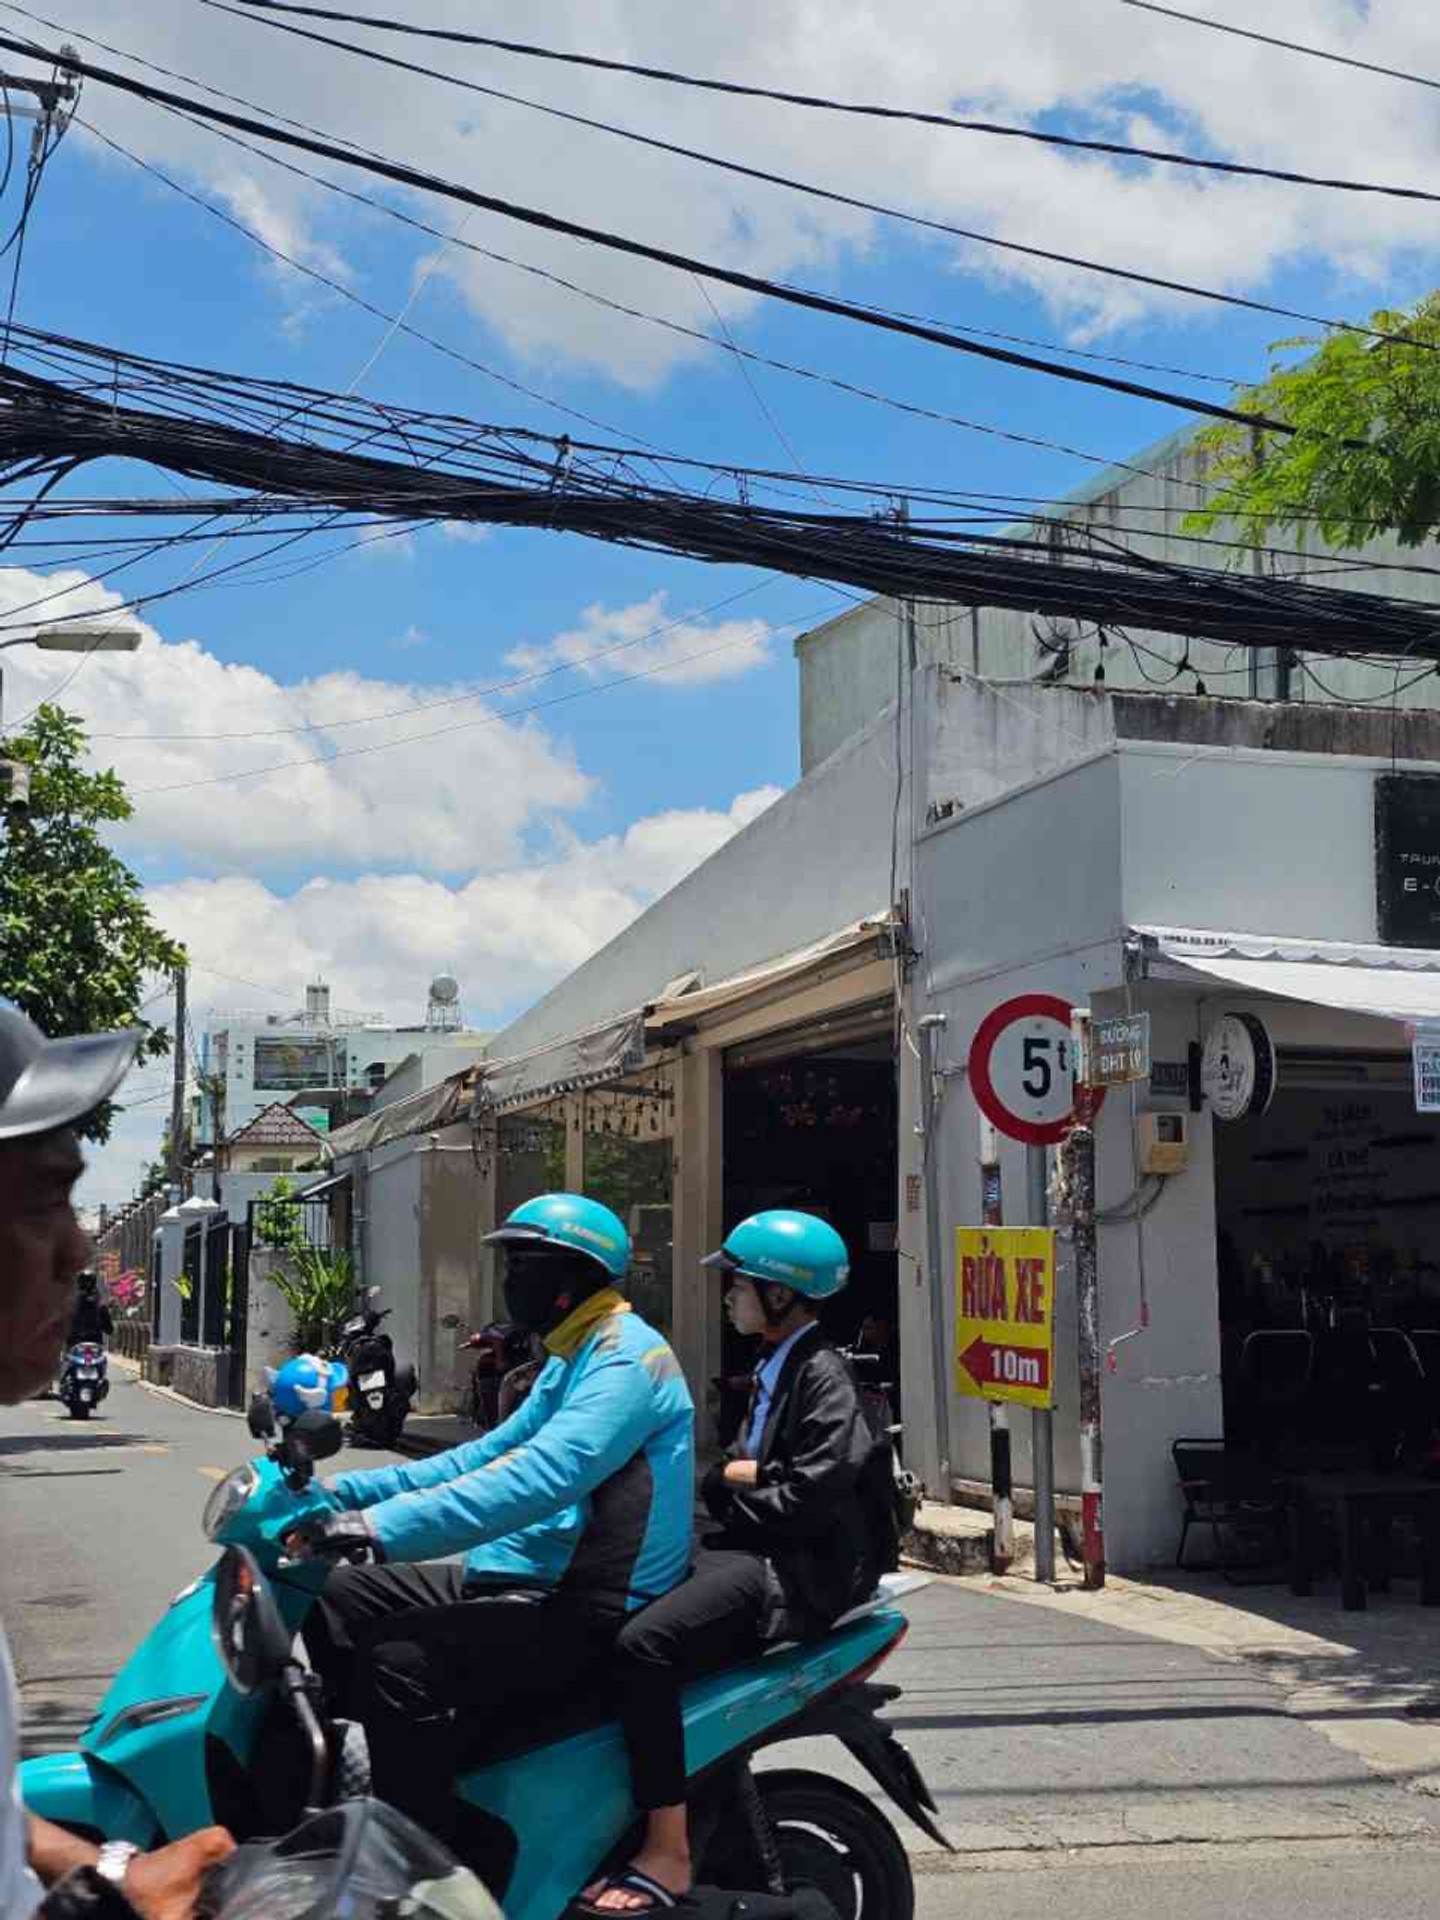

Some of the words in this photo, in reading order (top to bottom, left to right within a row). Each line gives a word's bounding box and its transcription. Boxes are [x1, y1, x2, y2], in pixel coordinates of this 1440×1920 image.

[961, 1235, 1008, 1322] RỬA
[1015, 1257, 1045, 1324] XE
[990, 1349, 1040, 1384] 10m
